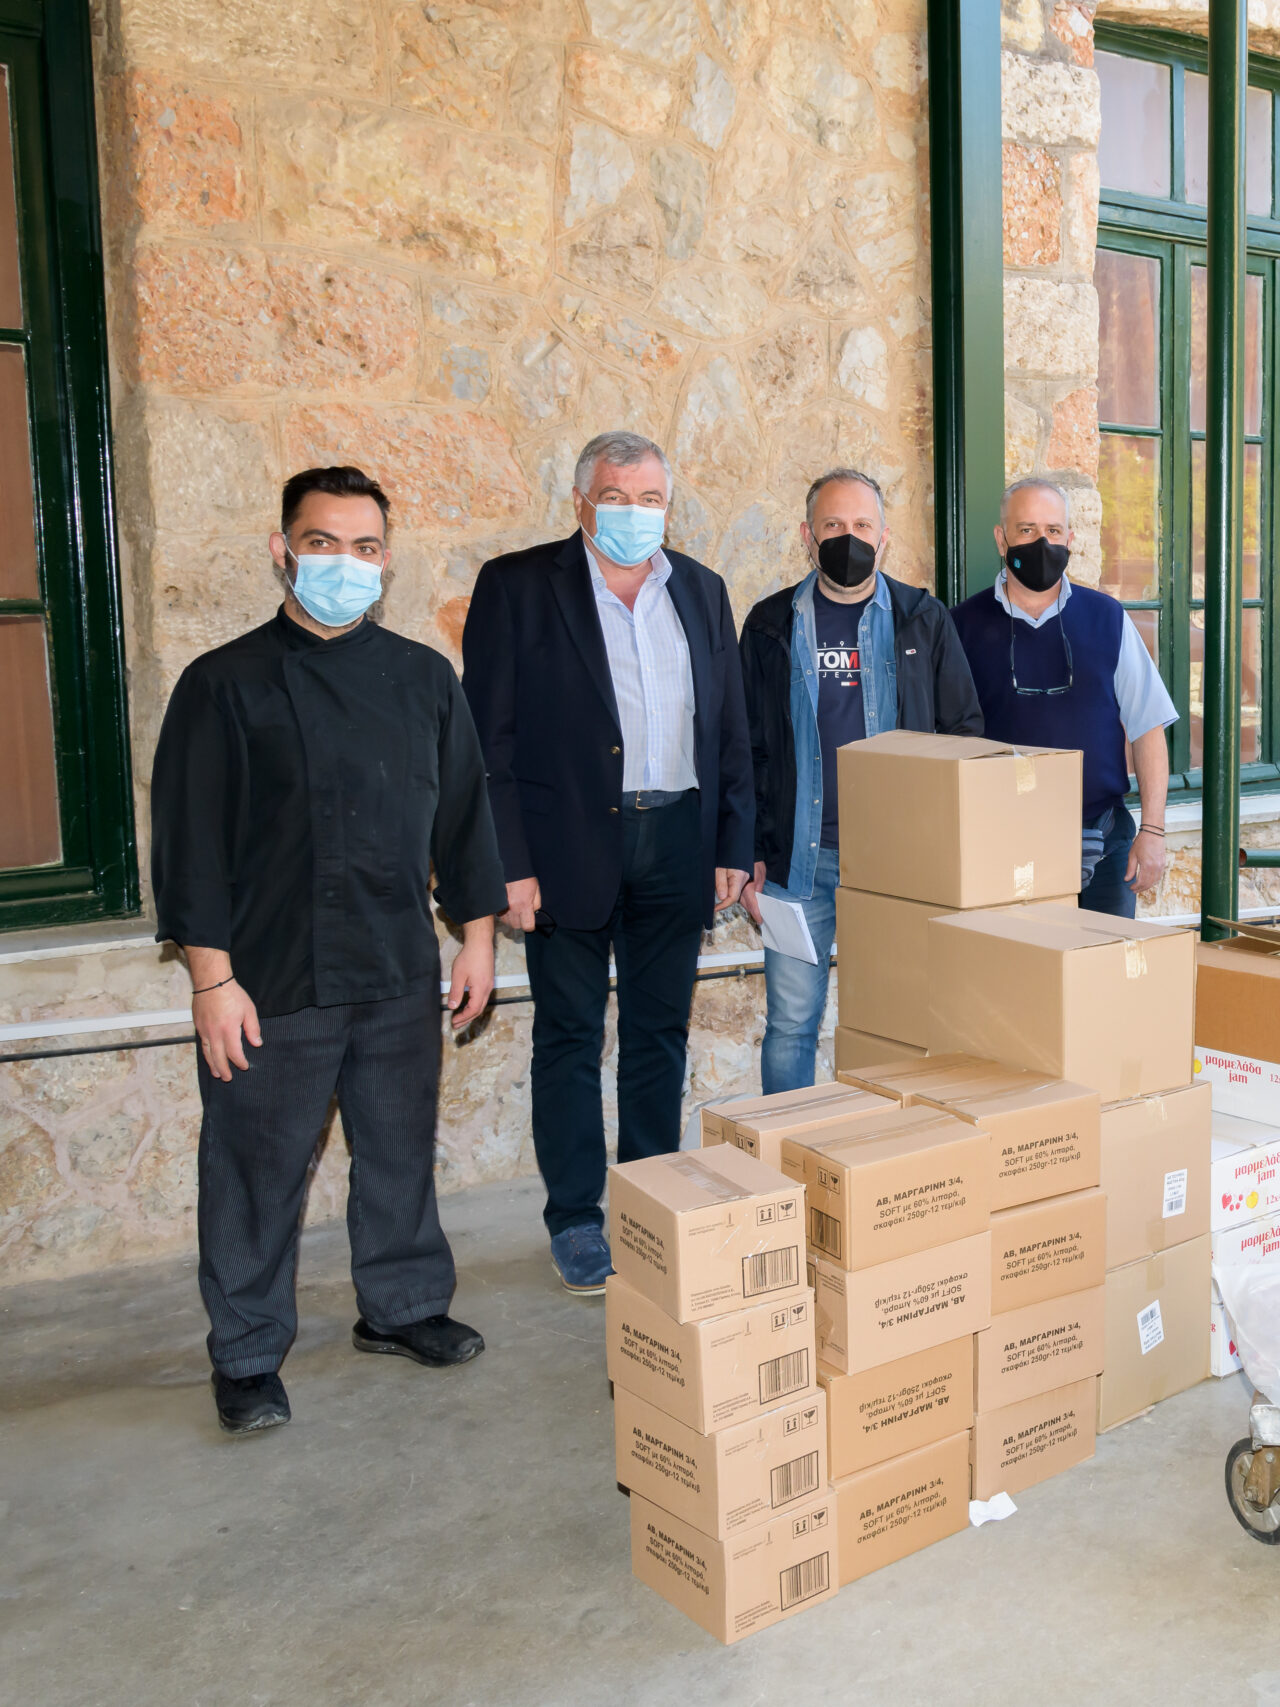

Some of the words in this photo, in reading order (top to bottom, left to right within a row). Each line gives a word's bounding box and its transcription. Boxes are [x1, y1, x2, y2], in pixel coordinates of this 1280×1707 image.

[817, 651, 860, 669] TOM
[1205, 1055, 1261, 1075] μαρμελάδα
[1228, 1070, 1248, 1084] jam
[1018, 1136, 1063, 1152] ΜΑΡΓΑΡΙΝΗ
[1005, 1156, 1024, 1166] SOFT
[1257, 1170, 1276, 1184] jam
[894, 1181, 945, 1201] ΜΑΡΓΑΡΙΝΗ
[880, 1206, 901, 1218] SOFT
[903, 1204, 913, 1214] με
[914, 1198, 929, 1208] 60%
[1020, 1236, 1066, 1254] ΜΑΡΓΑΡΙΝΗ
[1262, 1241, 1280, 1257] jam
[1007, 1258, 1026, 1269] SOFT
[942, 1285, 961, 1297] SOFT
[897, 1301, 948, 1323] ΜΑΡΓΑΡΙΝΗ
[1020, 1326, 1065, 1346] ΜΑΡΓΑΡΙΝΗ
[1007, 1350, 1026, 1362] SOFT
[1018, 1416, 1061, 1440] ΜΑΡΓΑΡΙΝΗ
[1006, 1443, 1024, 1456] SOFT
[877, 1484, 927, 1512] ΜΑΡΓΑΡΙΝΗ
[864, 1515, 883, 1530] SOFT
